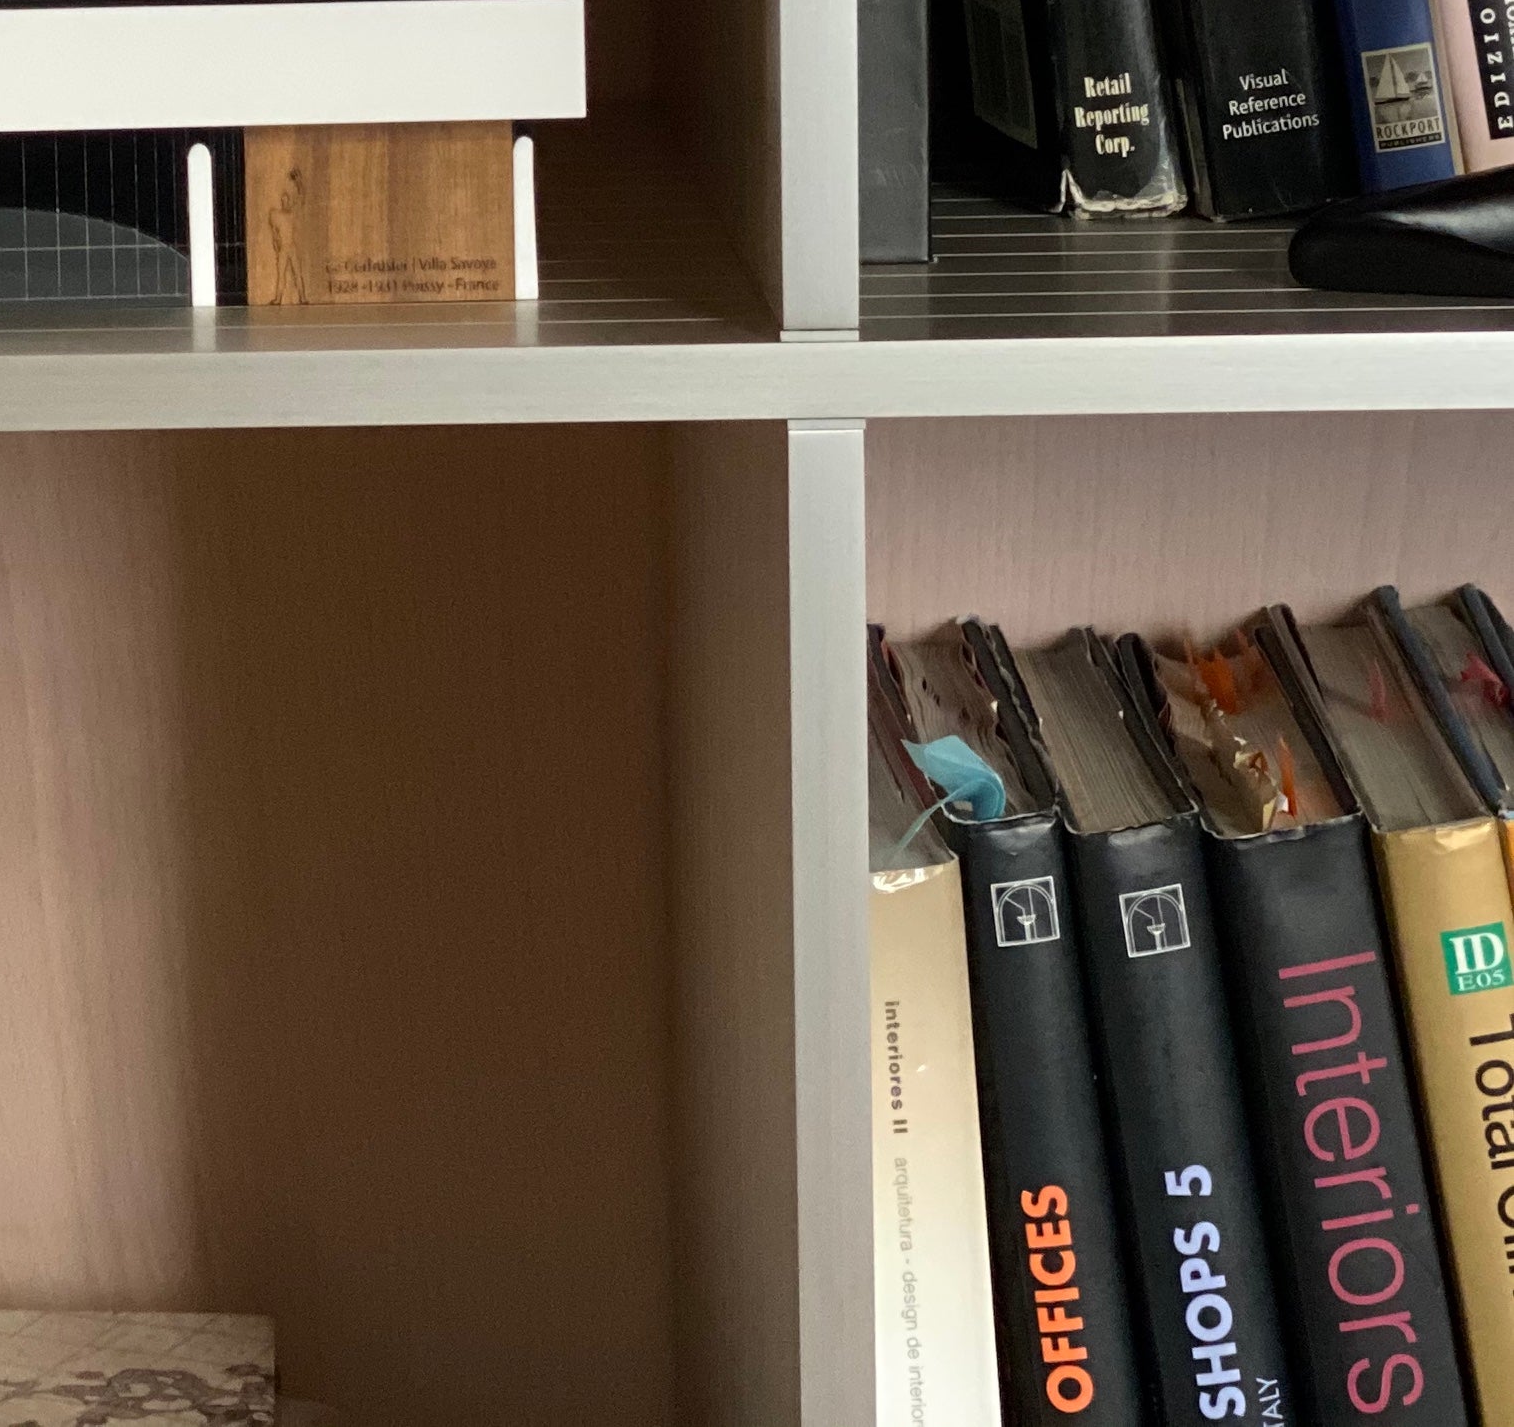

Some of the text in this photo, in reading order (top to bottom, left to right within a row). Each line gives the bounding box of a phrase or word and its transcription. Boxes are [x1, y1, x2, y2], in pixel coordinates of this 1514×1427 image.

[1084, 72, 1132, 98] Retail
[1239, 68, 1289, 91] Visual
[1074, 103, 1150, 131] Reporting
[1228, 92, 1306, 117] Reference
[1222, 112, 1320, 140] Publications
[1375, 117, 1441, 140] ROCKPORT
[1095, 133, 1135, 157] Corp.
[454, 276, 500, 292] France
[1449, 932, 1504, 974] ID
[884, 1000, 903, 1111] interiores
[892, 1118, 908, 1135] II
[1279, 950, 1424, 1415] Interiors
[893, 1157, 913, 1252] arquitetura
[901, 1270, 921, 1331] design
[1020, 1185, 1094, 1413] OFFICES
[1164, 1164, 1246, 1421] SHOPS 5
[906, 1336, 922, 1360] de
